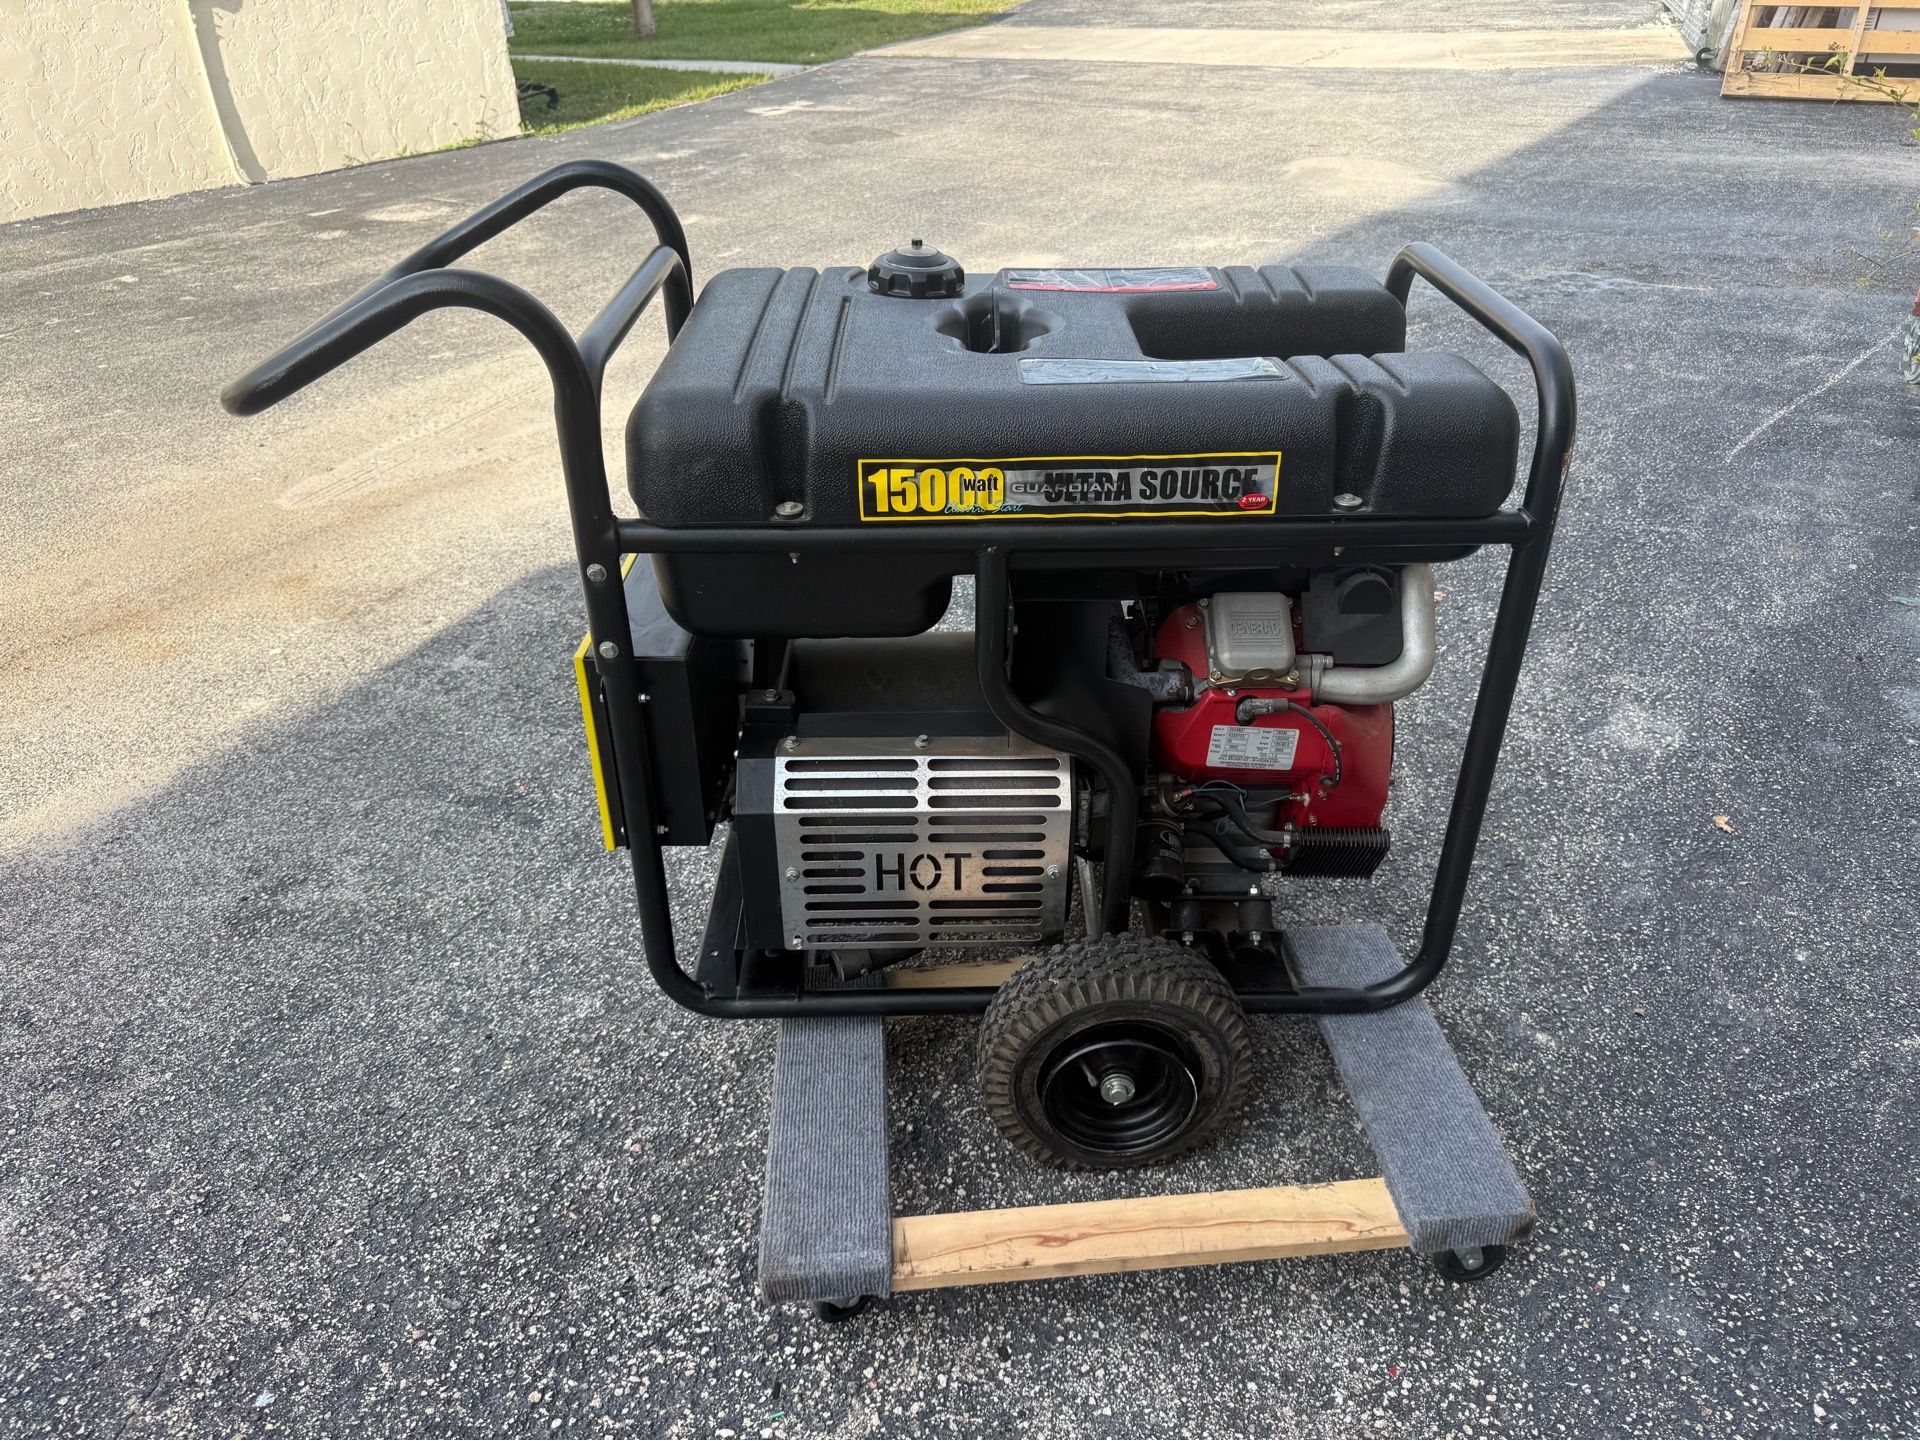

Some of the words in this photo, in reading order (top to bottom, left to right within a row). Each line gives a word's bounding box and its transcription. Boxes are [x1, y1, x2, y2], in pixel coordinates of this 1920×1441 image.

[867, 467, 1004, 512] 15000
[963, 476, 998, 491] watt
[1012, 482, 1117, 493] GUARDIAN
[1044, 471, 1132, 502] ULTRA
[1139, 468, 1259, 500] SOURCE
[1231, 619, 1281, 635] GENERAC
[875, 853, 972, 892] HOT
